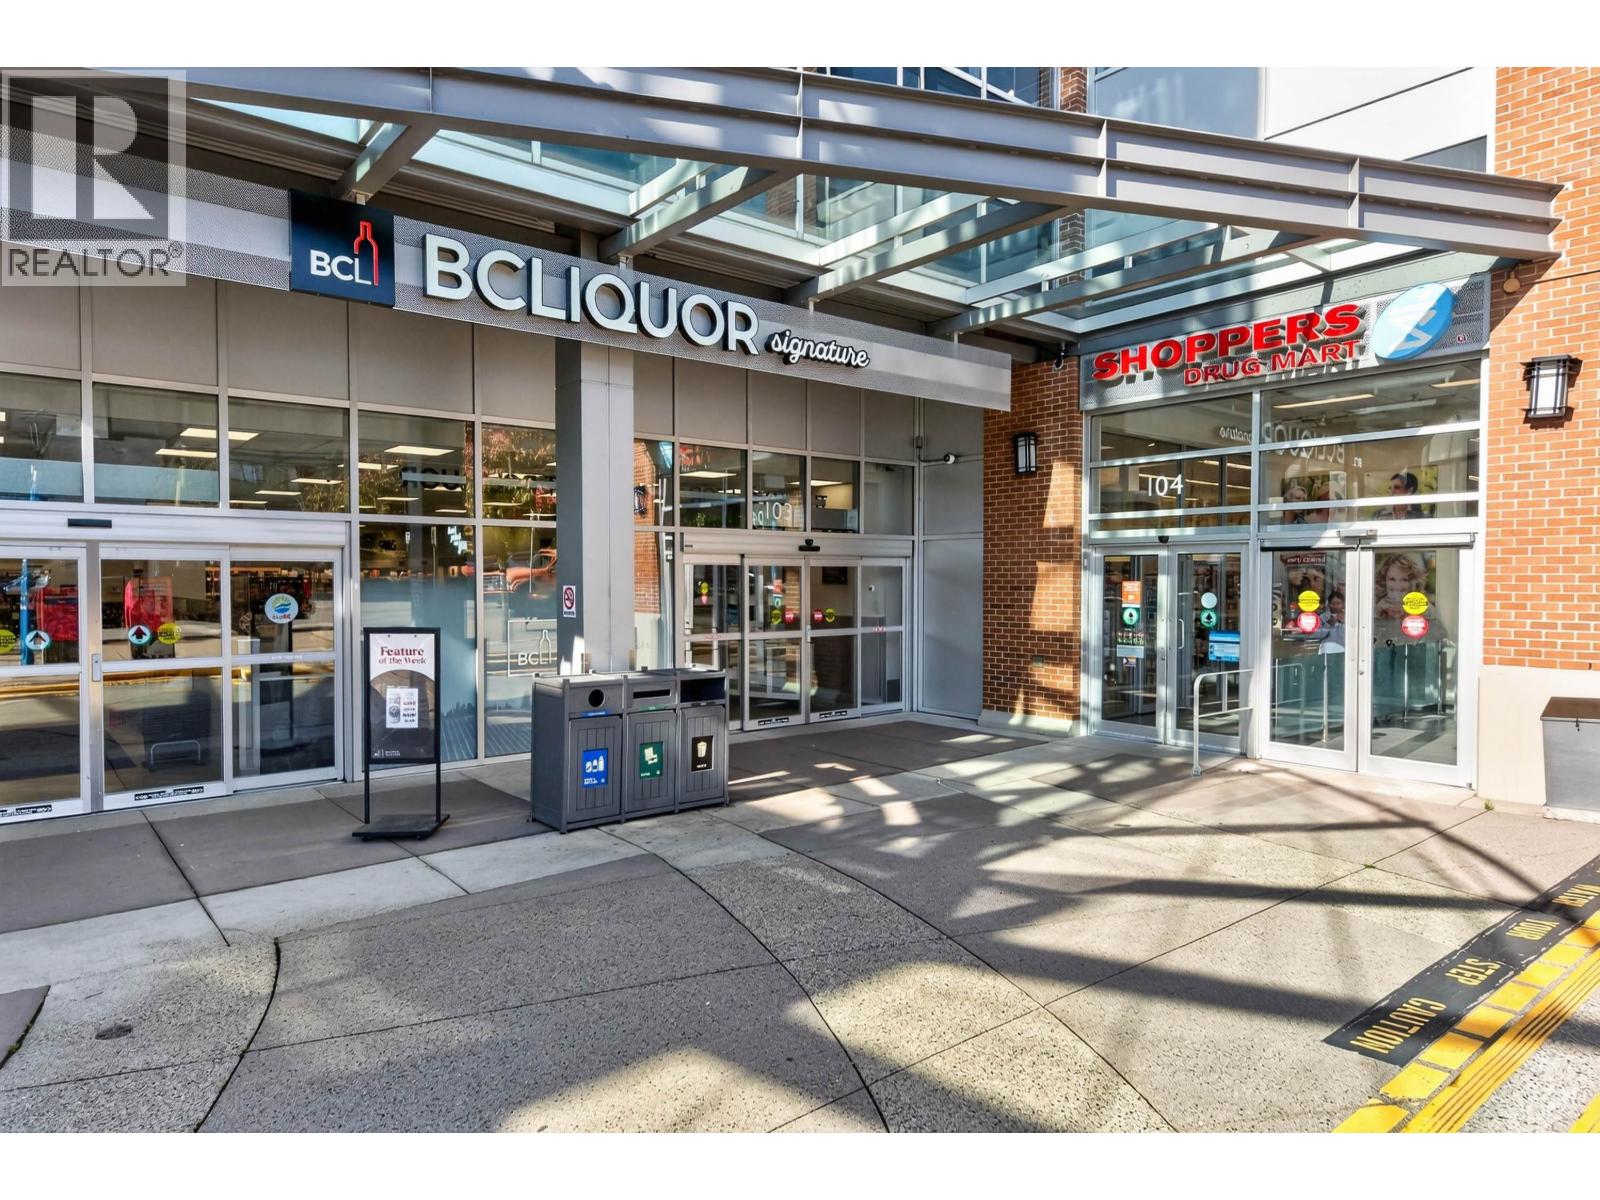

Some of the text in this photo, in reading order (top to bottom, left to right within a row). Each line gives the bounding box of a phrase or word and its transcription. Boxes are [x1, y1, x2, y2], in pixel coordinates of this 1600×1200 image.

[309, 249, 372, 286] BCL
[770, 328, 871, 367] signature
[1091, 303, 1363, 380] SHOPPERS
[1183, 338, 1361, 386] DRUG MART
[1148, 473, 1184, 497] 104
[766, 501, 793, 520] 103
[378, 656, 427, 665] of the Week
[380, 646, 425, 657] Feature
[517, 650, 548, 666] BCL
[1445, 957, 1502, 987] STEP
[1349, 996, 1448, 1055] CAUTION
